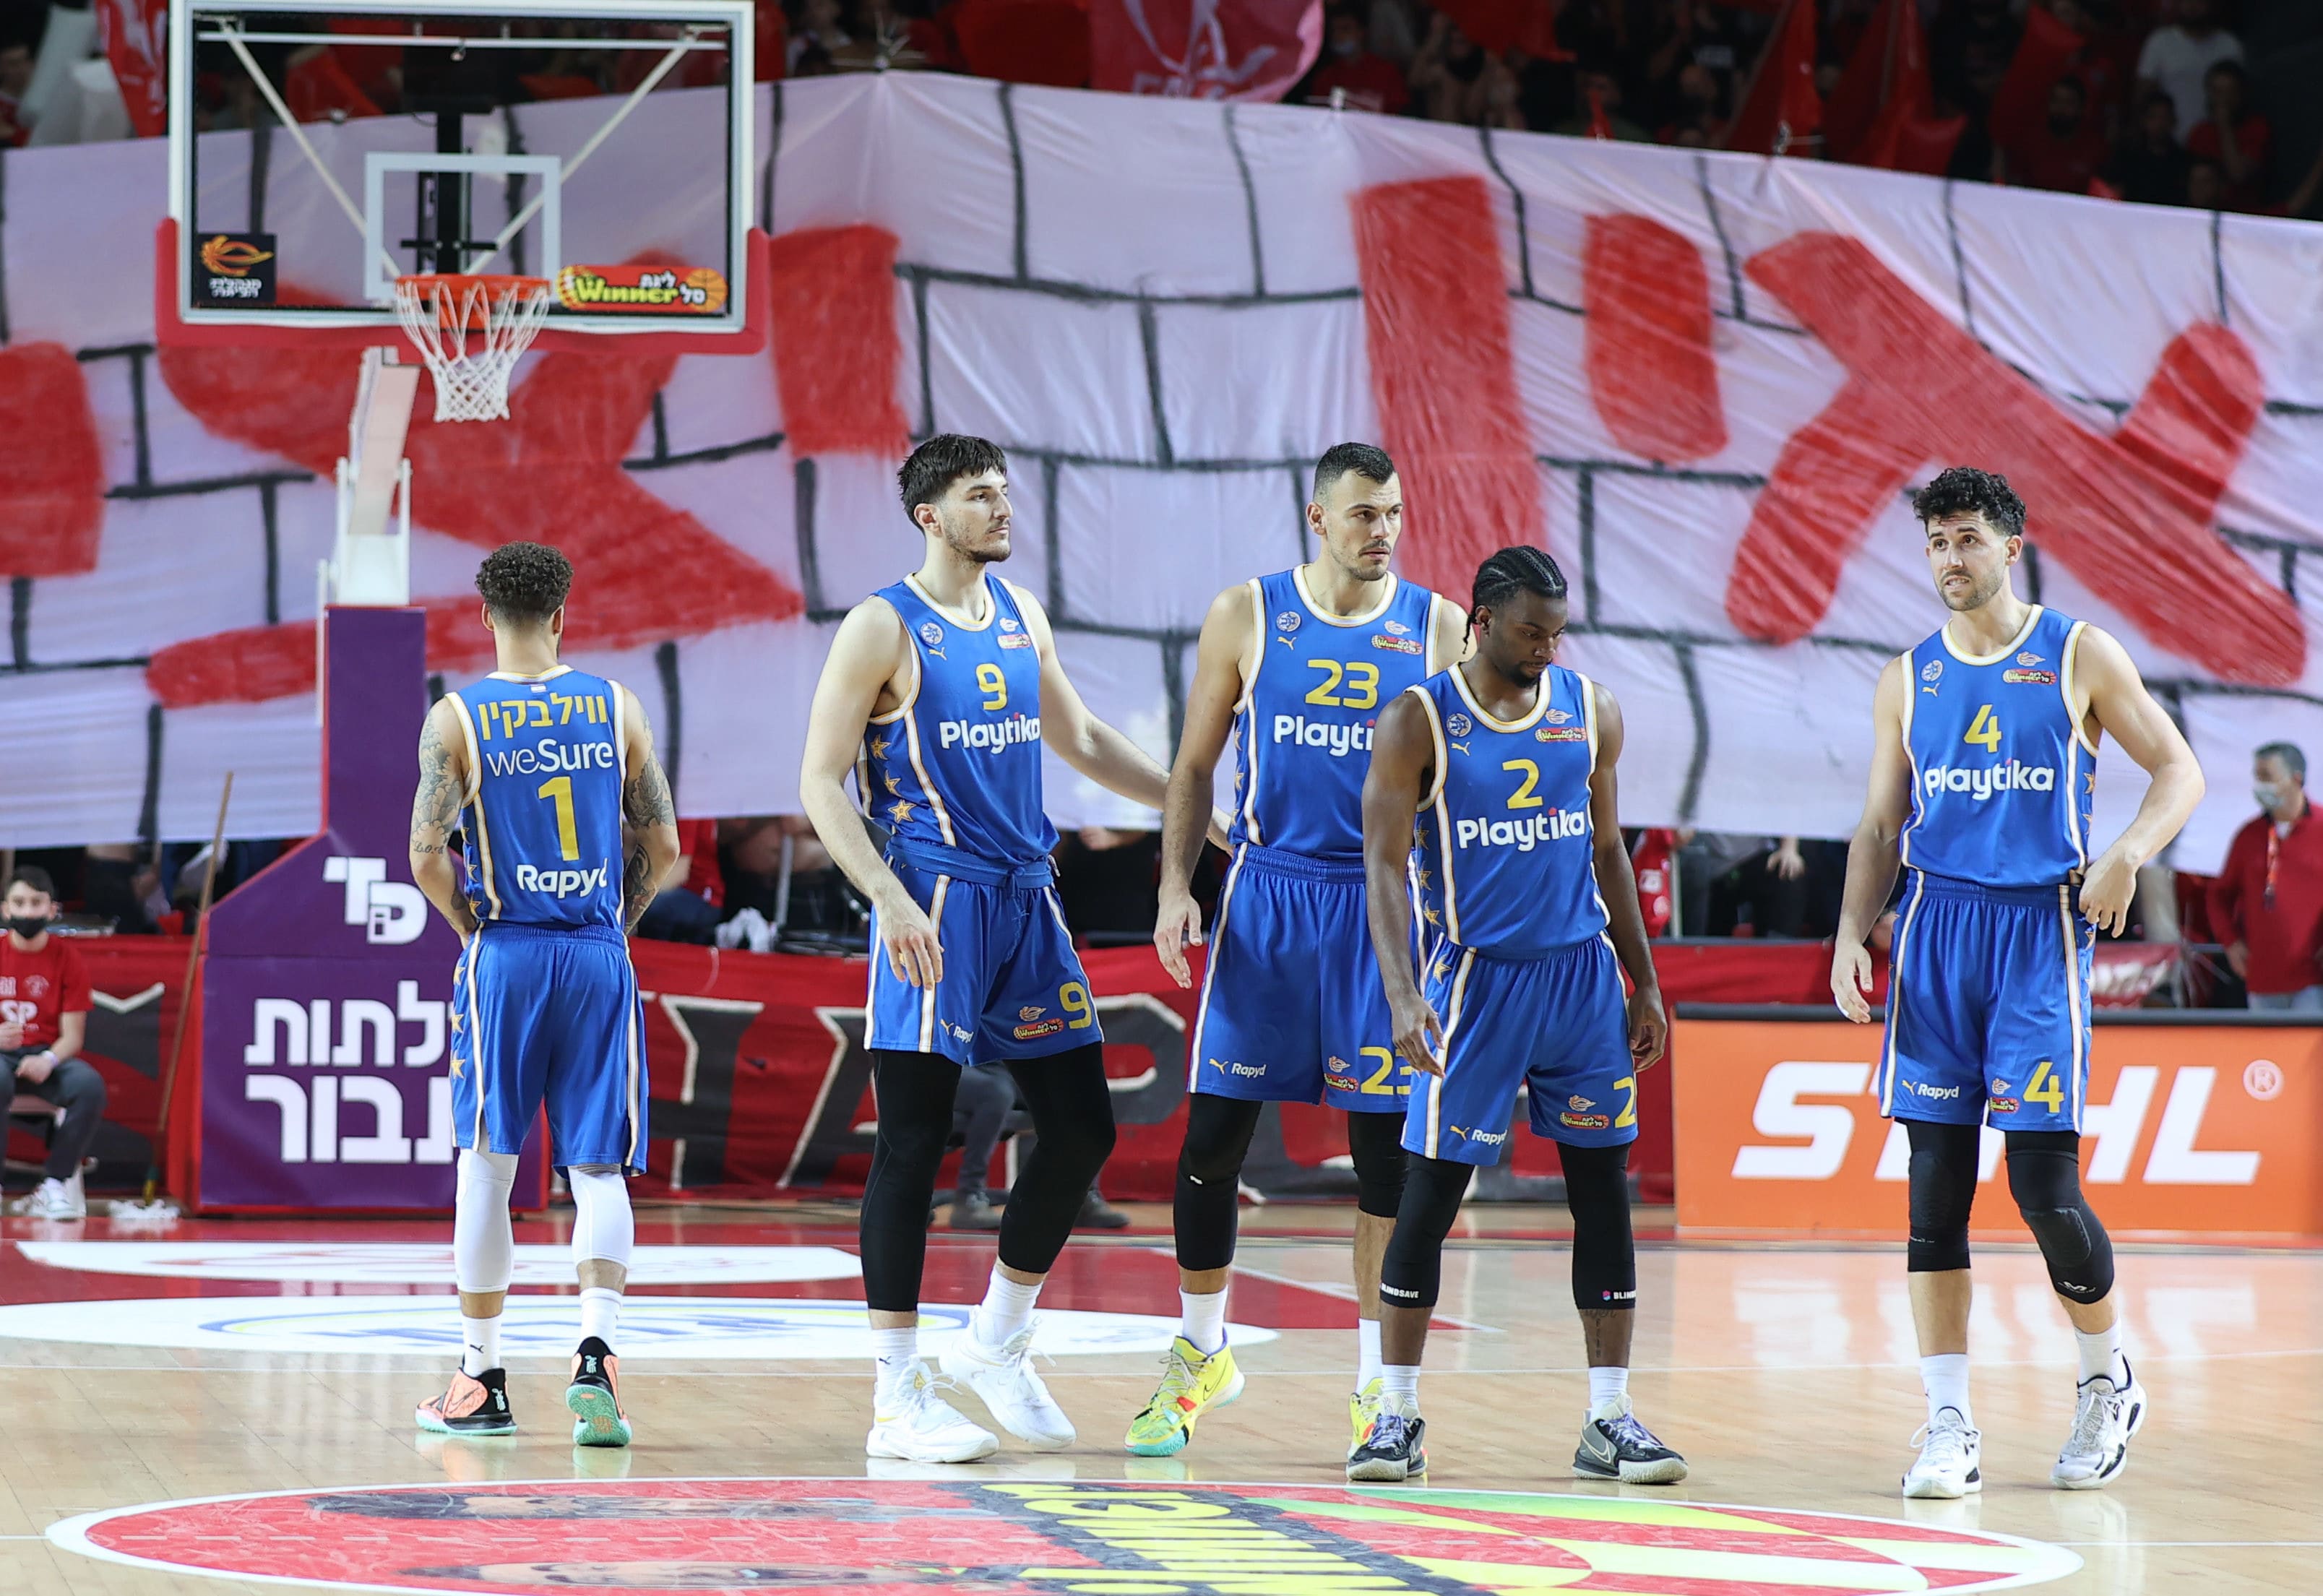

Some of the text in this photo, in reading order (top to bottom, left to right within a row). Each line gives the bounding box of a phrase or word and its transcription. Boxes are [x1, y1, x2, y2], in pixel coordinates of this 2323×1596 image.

[575, 277, 706, 304] Winner סל
[975, 663, 1008, 710] 9
[1305, 659, 1380, 710] 23
[478, 692, 608, 741] ווילבקין
[1274, 715, 1376, 757] Playti
[1963, 704, 2002, 754] 4
[486, 738, 613, 777] weSure
[1502, 759, 1543, 809] 2
[538, 776, 579, 861] 1
[1456, 807, 1585, 852] Playtika
[244, 980, 454, 1067] לתות
[1059, 981, 1092, 1030] 9
[1019, 1027, 1049, 1037] Winner
[1231, 1063, 1267, 1079] Rapyd
[1917, 1084, 1959, 1100] Rapyd
[2023, 1061, 2064, 1113] 4
[1613, 1077, 1636, 1128] 2
